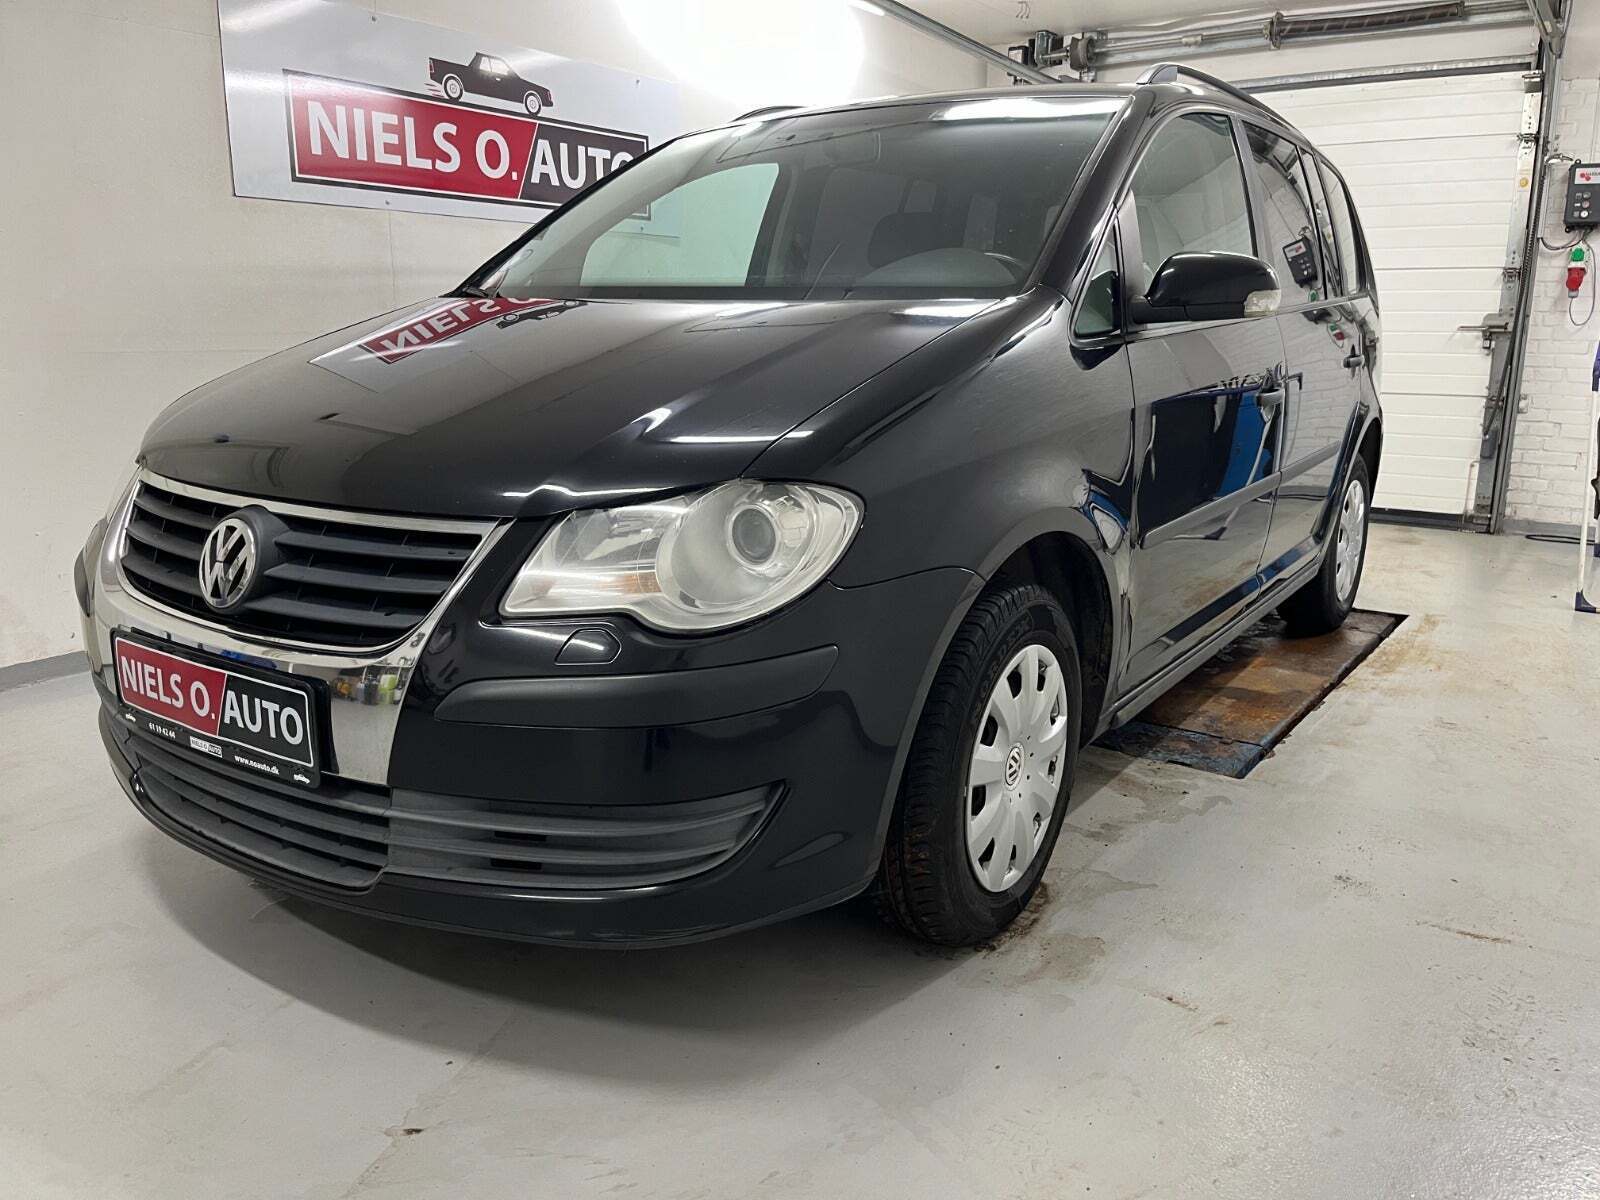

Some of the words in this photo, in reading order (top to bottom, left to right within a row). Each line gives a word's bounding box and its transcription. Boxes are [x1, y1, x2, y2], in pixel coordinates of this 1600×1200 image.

[307, 101, 460, 172] NIELS
[475, 130, 518, 181] O.
[120, 655, 185, 708] NIELS
[190, 680, 216, 719] O.
[224, 690, 304, 745] AUTO
